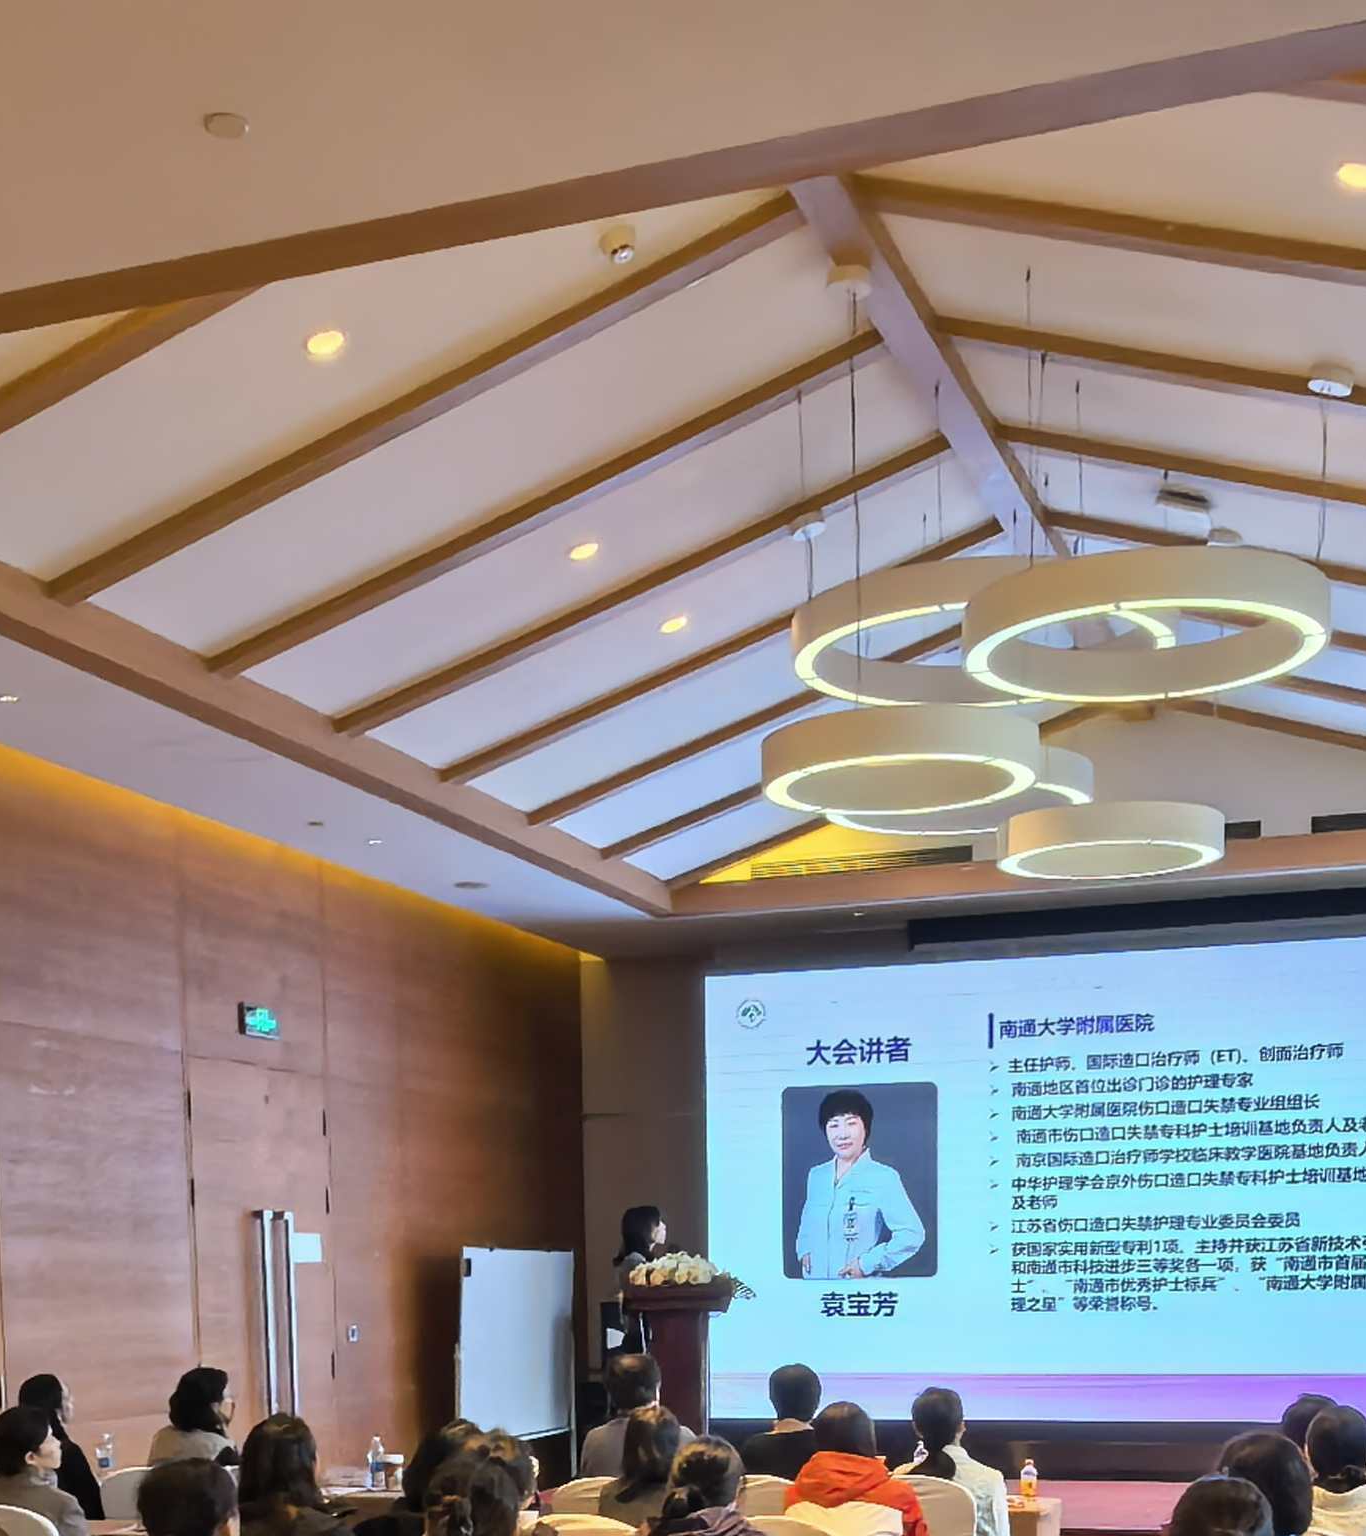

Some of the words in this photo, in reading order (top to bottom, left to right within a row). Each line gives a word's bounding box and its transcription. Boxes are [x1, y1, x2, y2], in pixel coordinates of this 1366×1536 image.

[999, 1013, 1155, 1039] 南通大学附属医院
[806, 1036, 912, 1065] 大会讲者
[1011, 1094, 1320, 1122] 南通大学附属医院伤口造口失禁专业组组长
[1011, 1195, 1058, 1210] 及老师
[1011, 1212, 1300, 1234] 江苏省伤口造口失禁护理专业委员会委员
[820, 1291, 899, 1317] 袁宝芳
